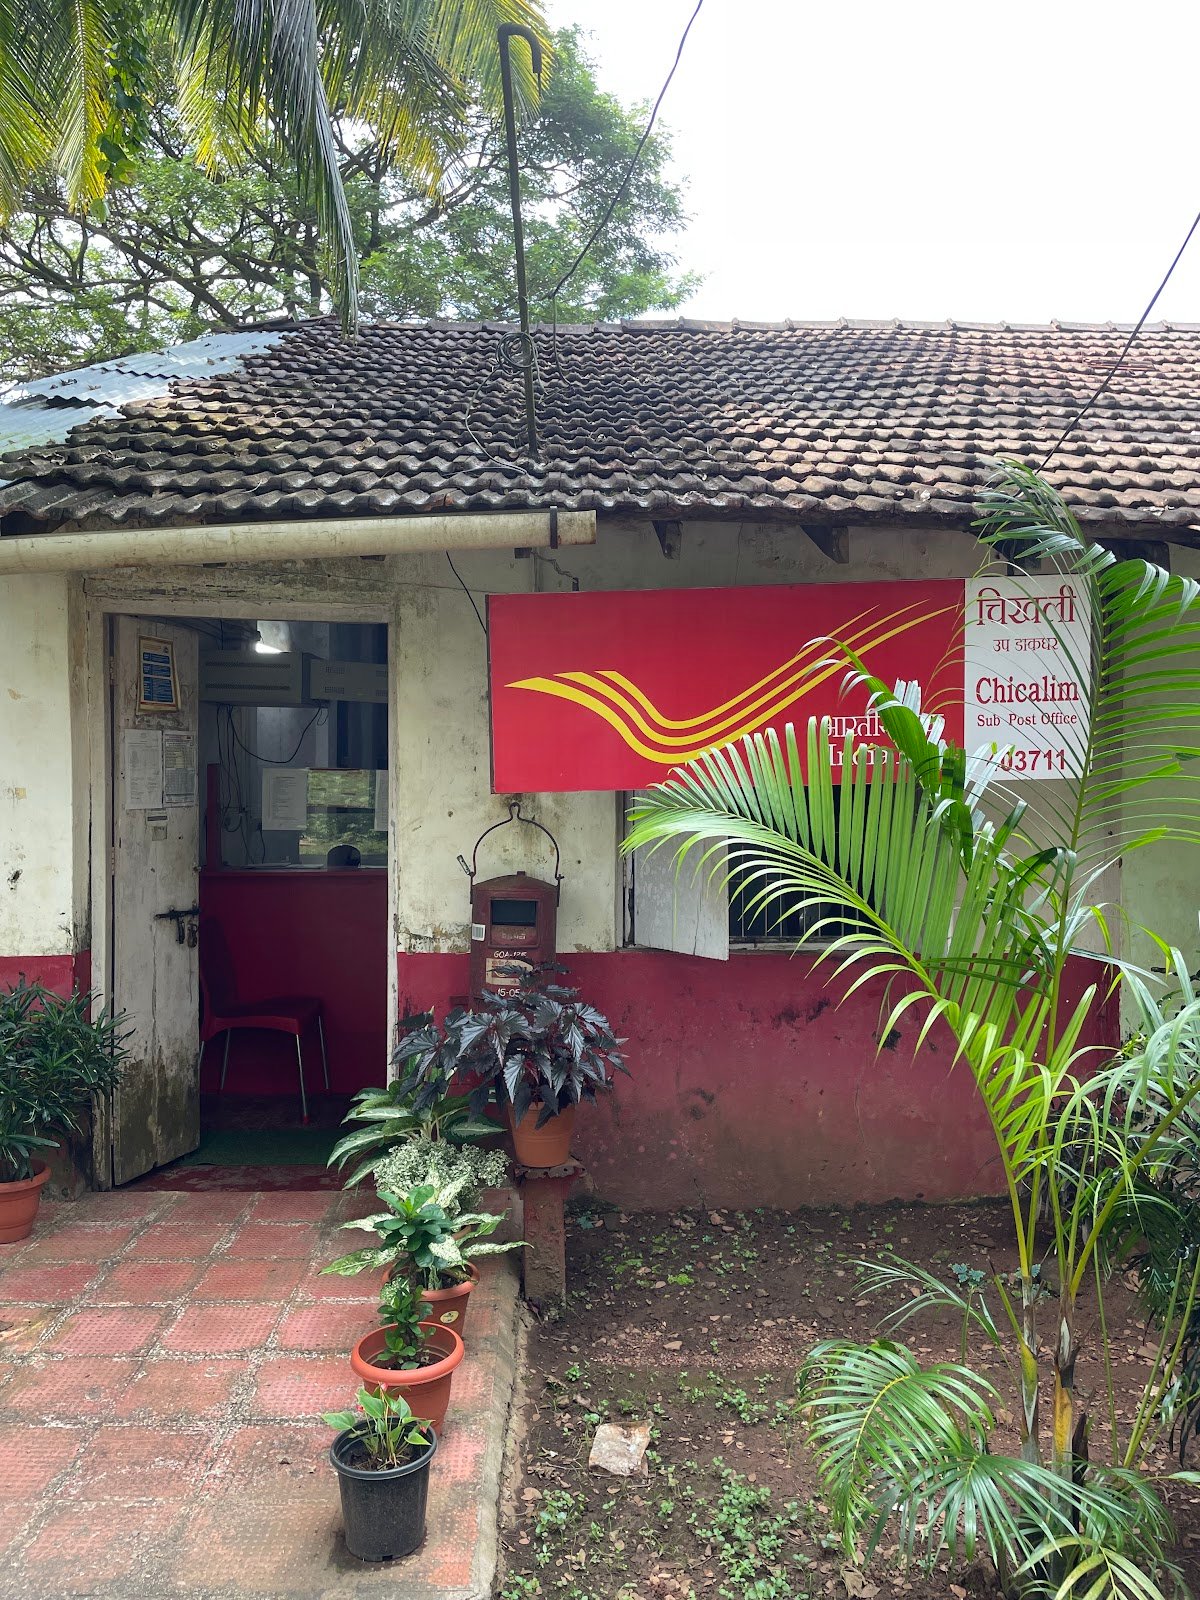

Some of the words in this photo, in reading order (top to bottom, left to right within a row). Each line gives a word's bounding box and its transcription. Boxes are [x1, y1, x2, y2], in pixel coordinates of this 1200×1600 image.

[993, 639, 1010, 652] उप
[975, 675, 1079, 704] Chicalim
[977, 714, 1000, 726] Sub
[1008, 713, 1037, 726] Post
[1040, 712, 1077, 725] Office
[986, 749, 1065, 771] 03711
